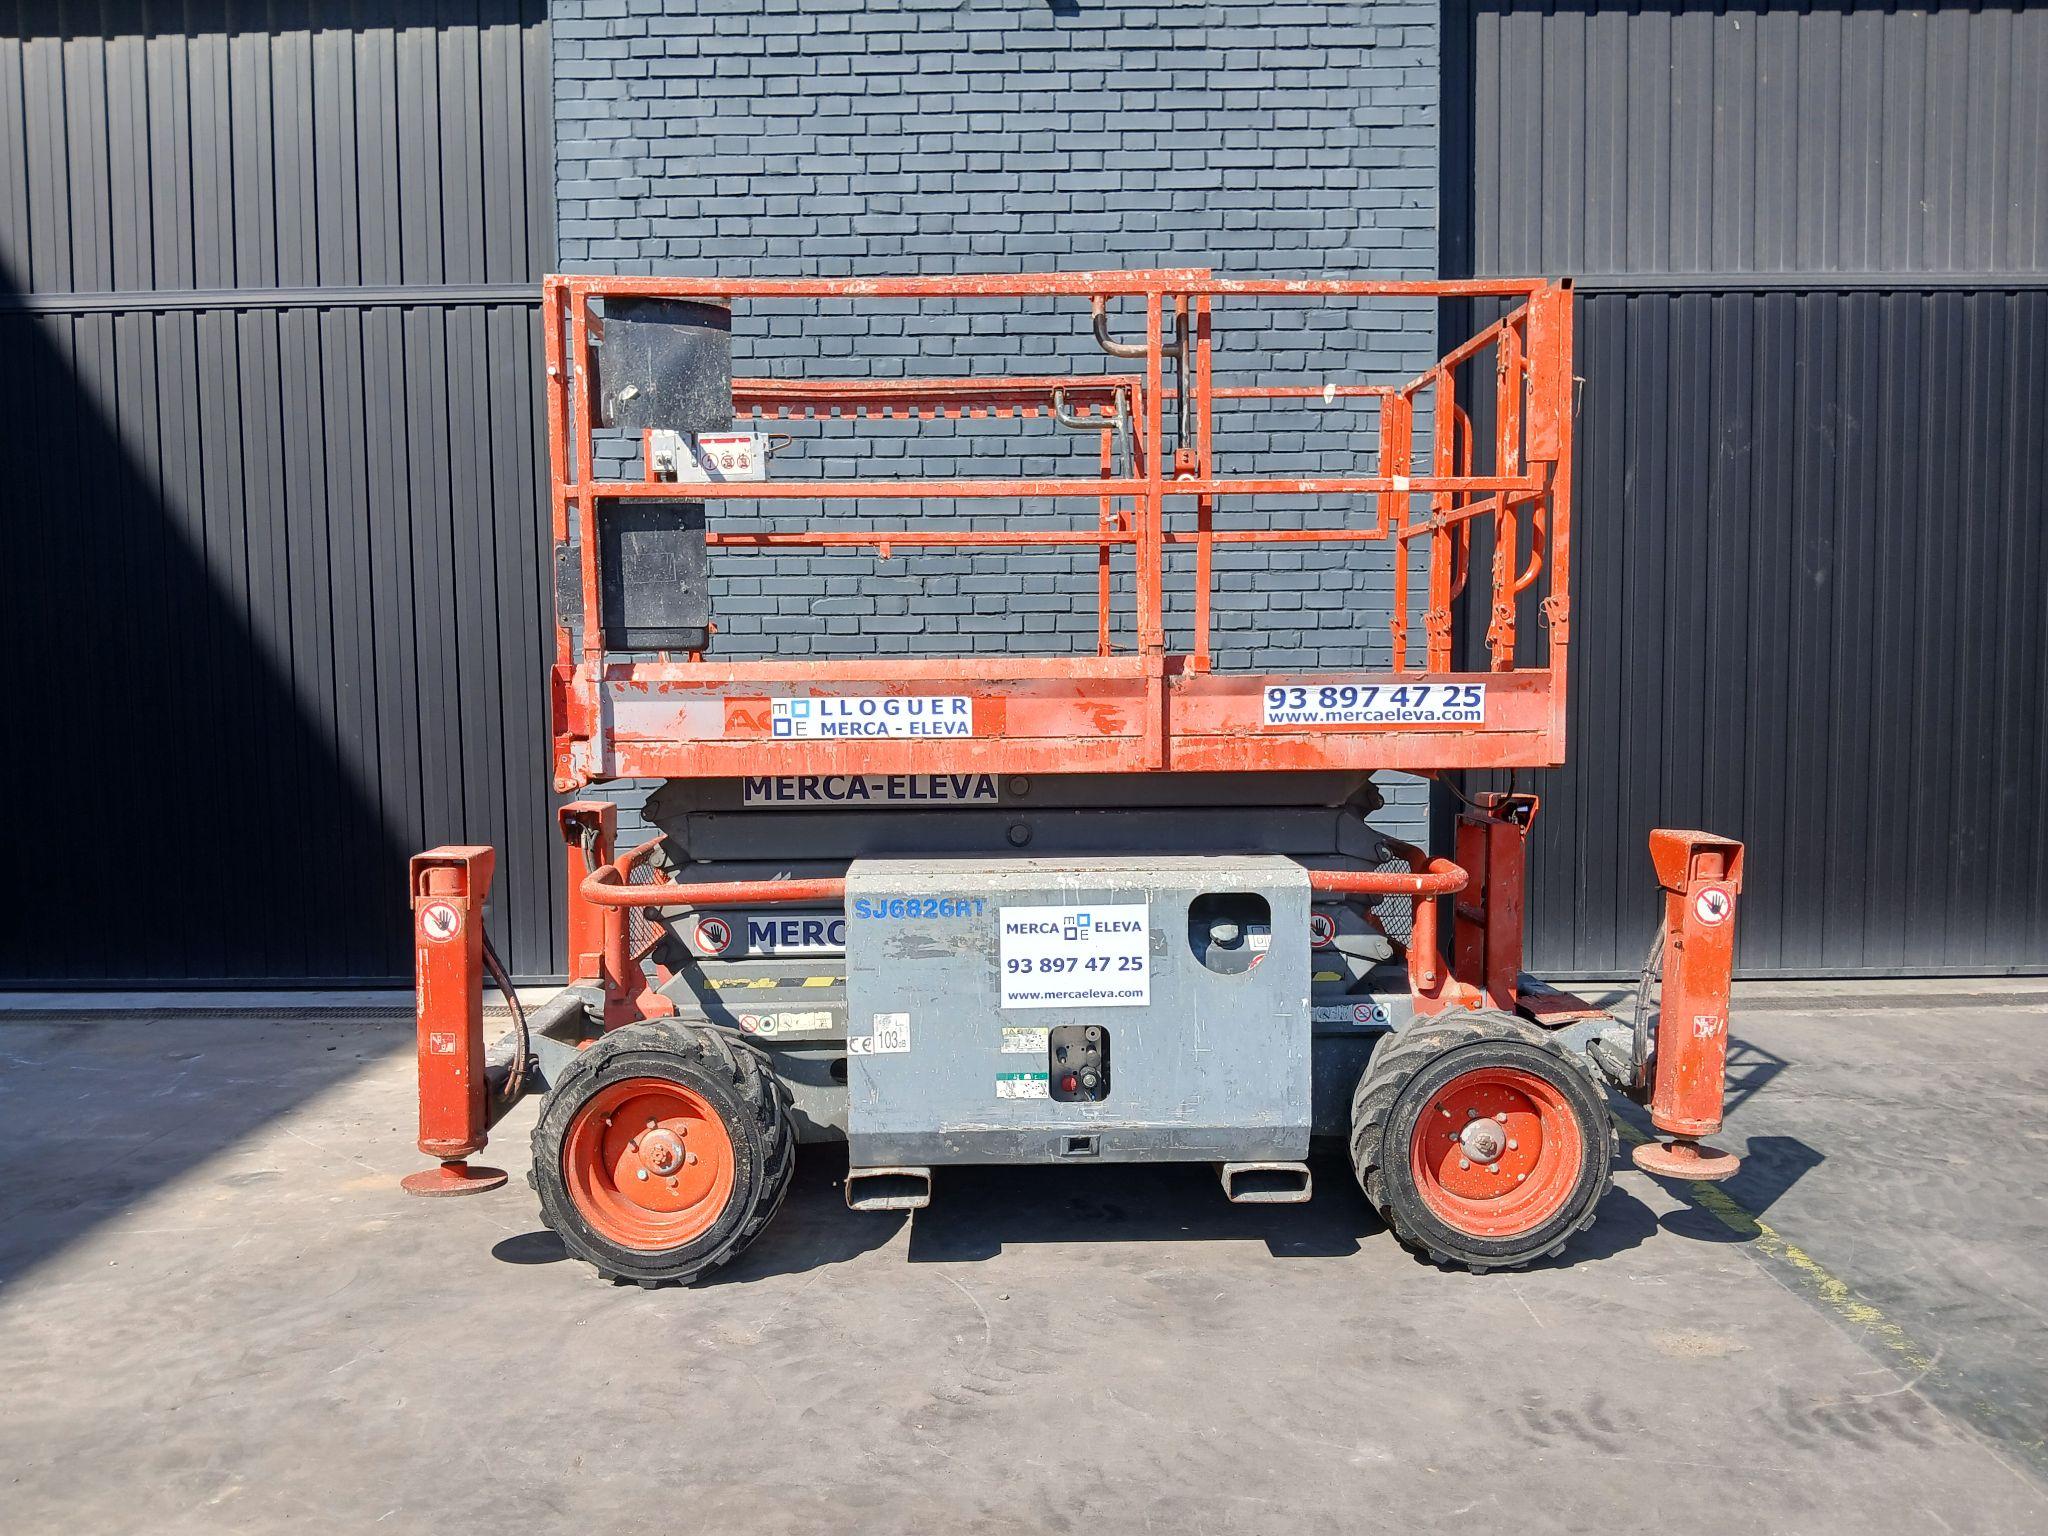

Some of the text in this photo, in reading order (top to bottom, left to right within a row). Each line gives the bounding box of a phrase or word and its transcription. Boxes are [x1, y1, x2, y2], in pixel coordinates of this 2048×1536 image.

[1268, 685, 1482, 709] 93 897 47 25
[820, 698, 968, 716] LLOGUER
[1268, 707, 1481, 723] www.mercaeleva.com
[820, 721, 889, 736] MERCA
[909, 720, 969, 735] ELEVA
[744, 774, 997, 801] MERCA-ELEVA
[854, 898, 988, 919] SJ6826RT
[1006, 922, 1060, 935] MERCA
[1095, 921, 1142, 933] ELEVA
[1007, 956, 1143, 974] 93 897 47 25
[1008, 988, 1143, 1000] www.mercaeleva.com
[878, 1030, 898, 1049] 103
